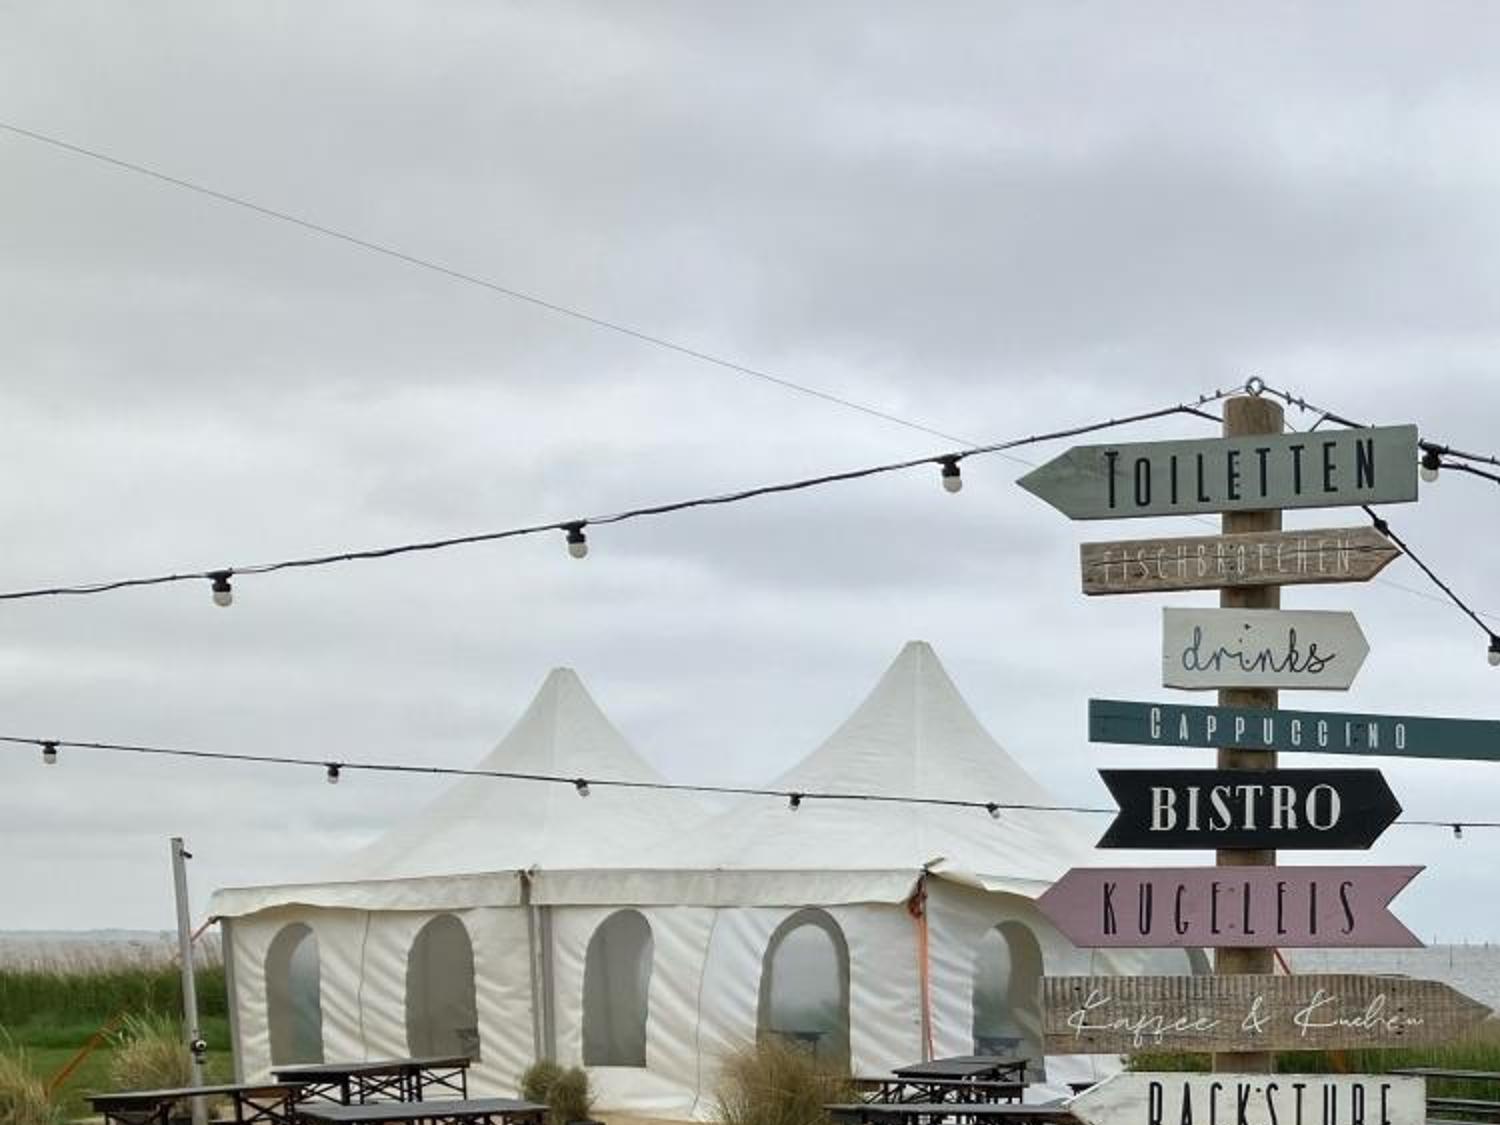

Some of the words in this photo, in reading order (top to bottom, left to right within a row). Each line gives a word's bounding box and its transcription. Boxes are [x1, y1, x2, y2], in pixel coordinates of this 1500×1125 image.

[1104, 439, 1376, 508] TOILETTEN
[1181, 626, 1337, 674] drinks
[1150, 706, 1406, 750] CAPPUCCINO
[1150, 783, 1342, 832] BISTRO
[1103, 880, 1355, 935] KUGELEIS
[1067, 989, 1220, 1047] Kaffee
[1241, 996, 1272, 1033] &
[1293, 989, 1424, 1036] Kuchen
